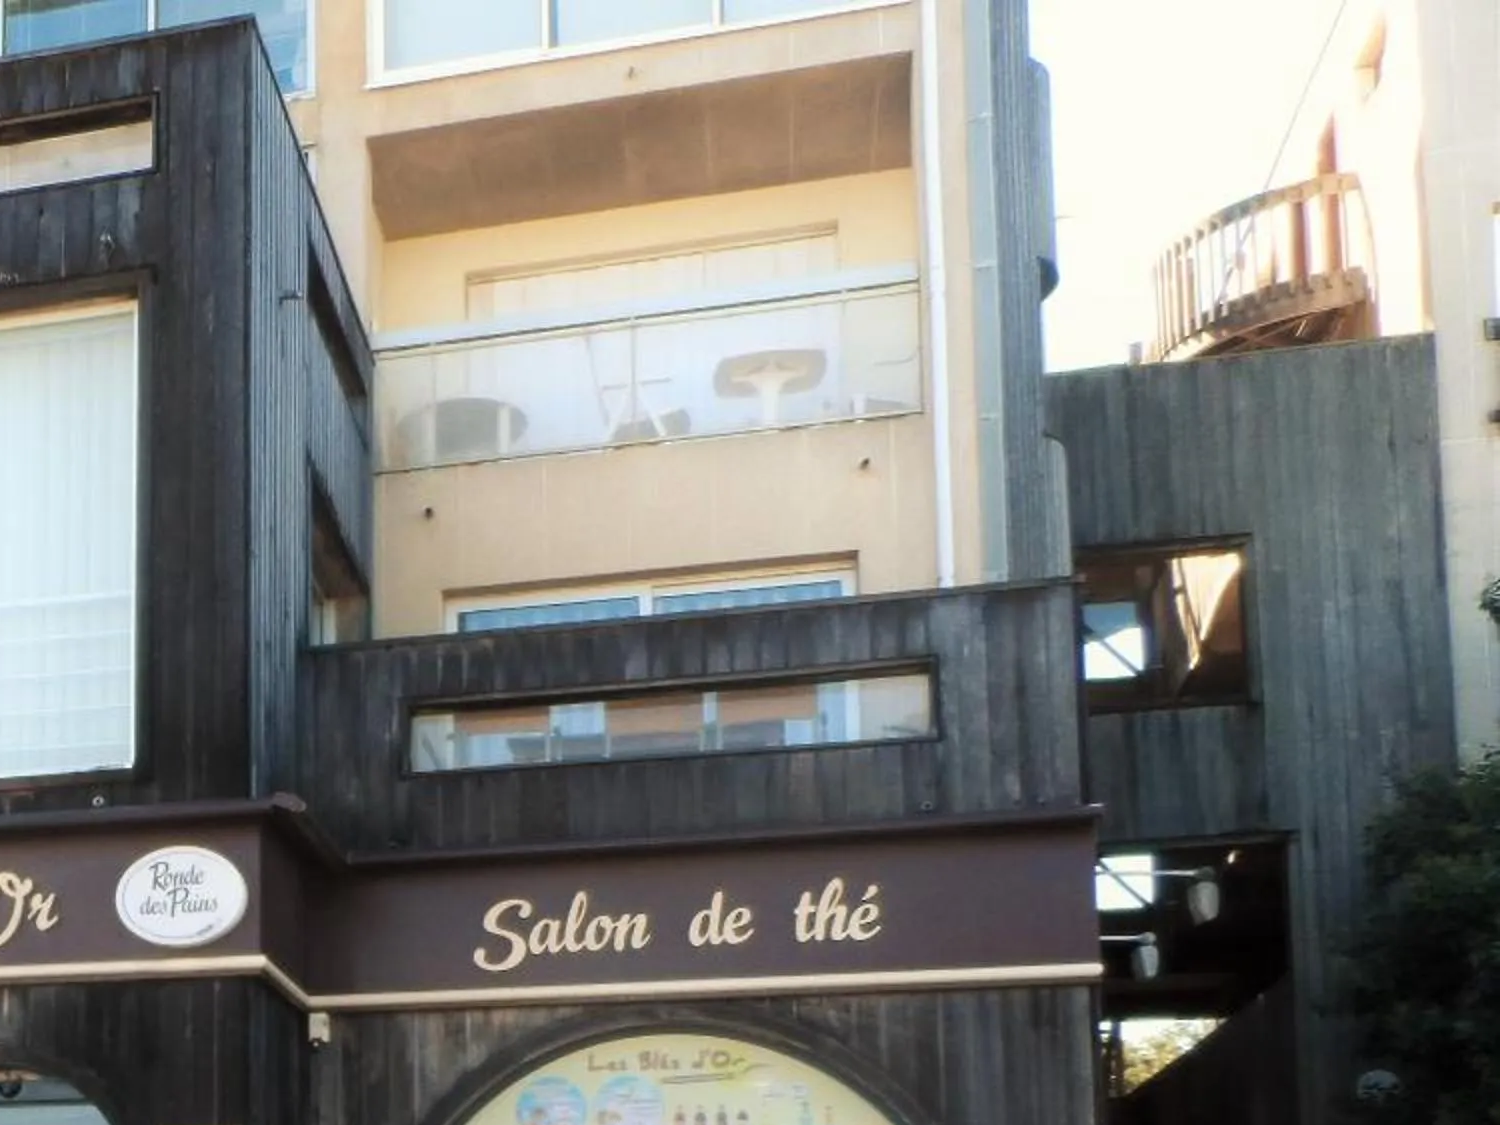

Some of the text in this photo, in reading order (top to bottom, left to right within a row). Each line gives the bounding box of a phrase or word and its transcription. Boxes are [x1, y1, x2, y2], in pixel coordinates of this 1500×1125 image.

[149, 861, 204, 891] Ronde
[139, 887, 218, 918] des Pains
[473, 877, 882, 972] Salon de thé
